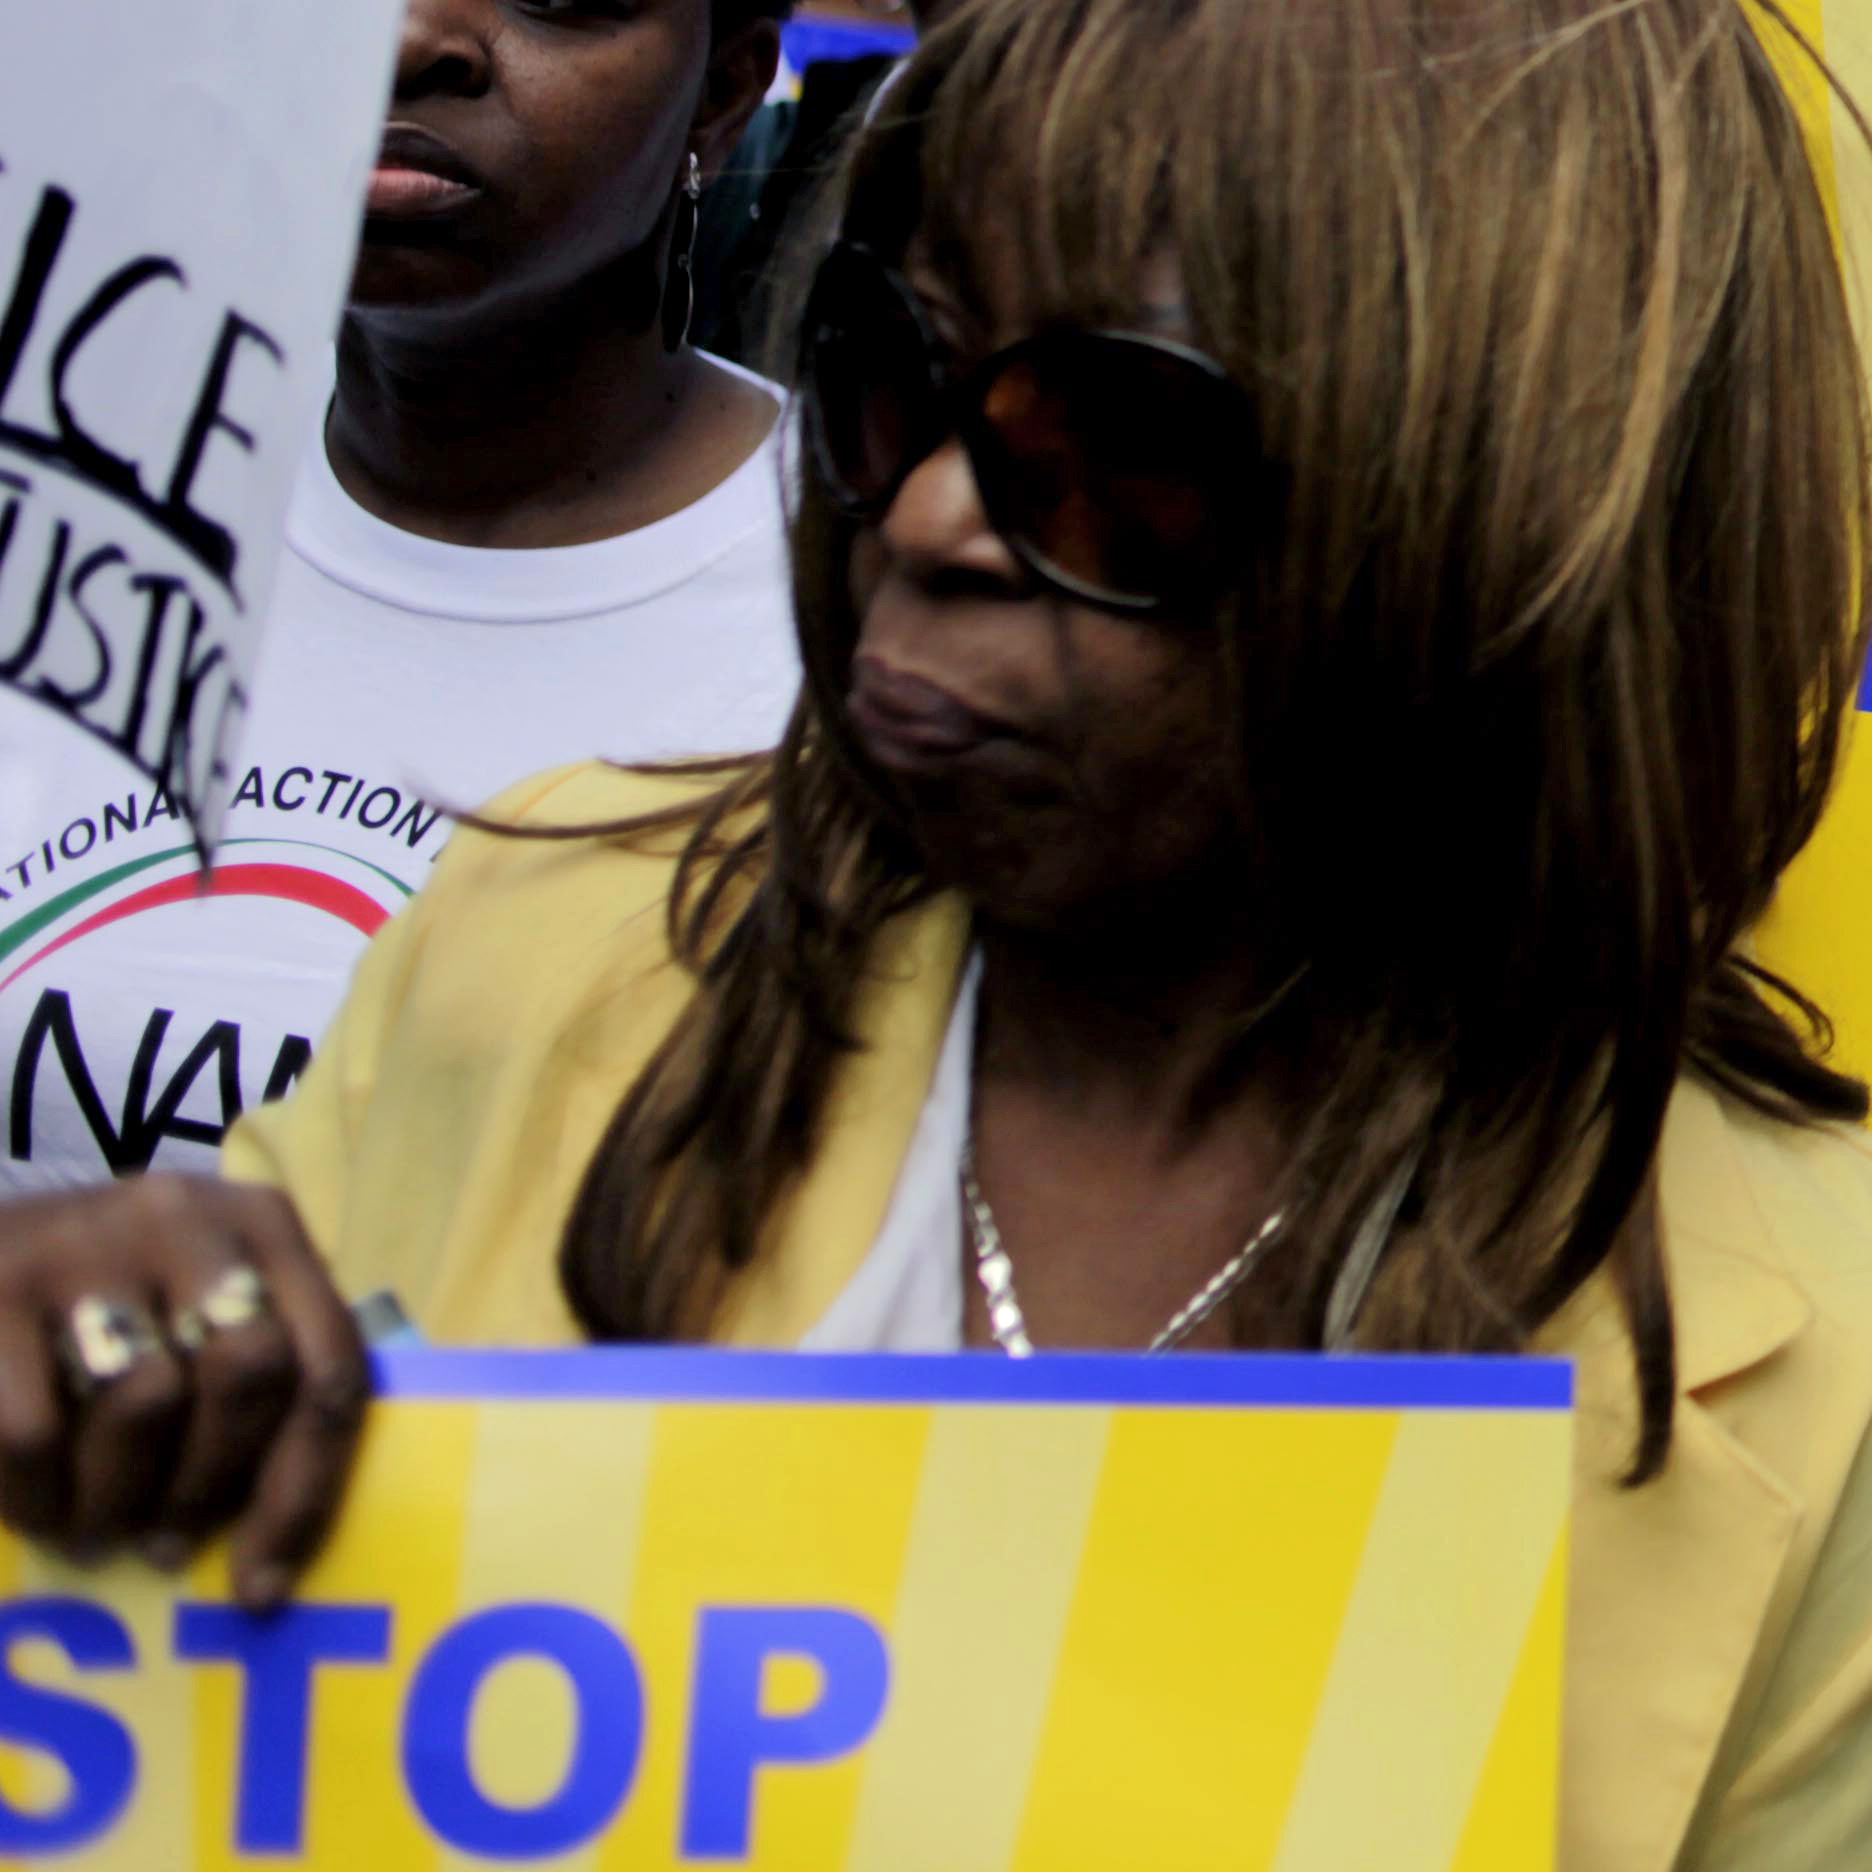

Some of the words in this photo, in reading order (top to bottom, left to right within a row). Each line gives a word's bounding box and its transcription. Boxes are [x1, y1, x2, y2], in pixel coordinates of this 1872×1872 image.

[0, 783, 186, 903] TIONA
[230, 765, 446, 849] ACTION
[0, 1595, 891, 1861] STOP
